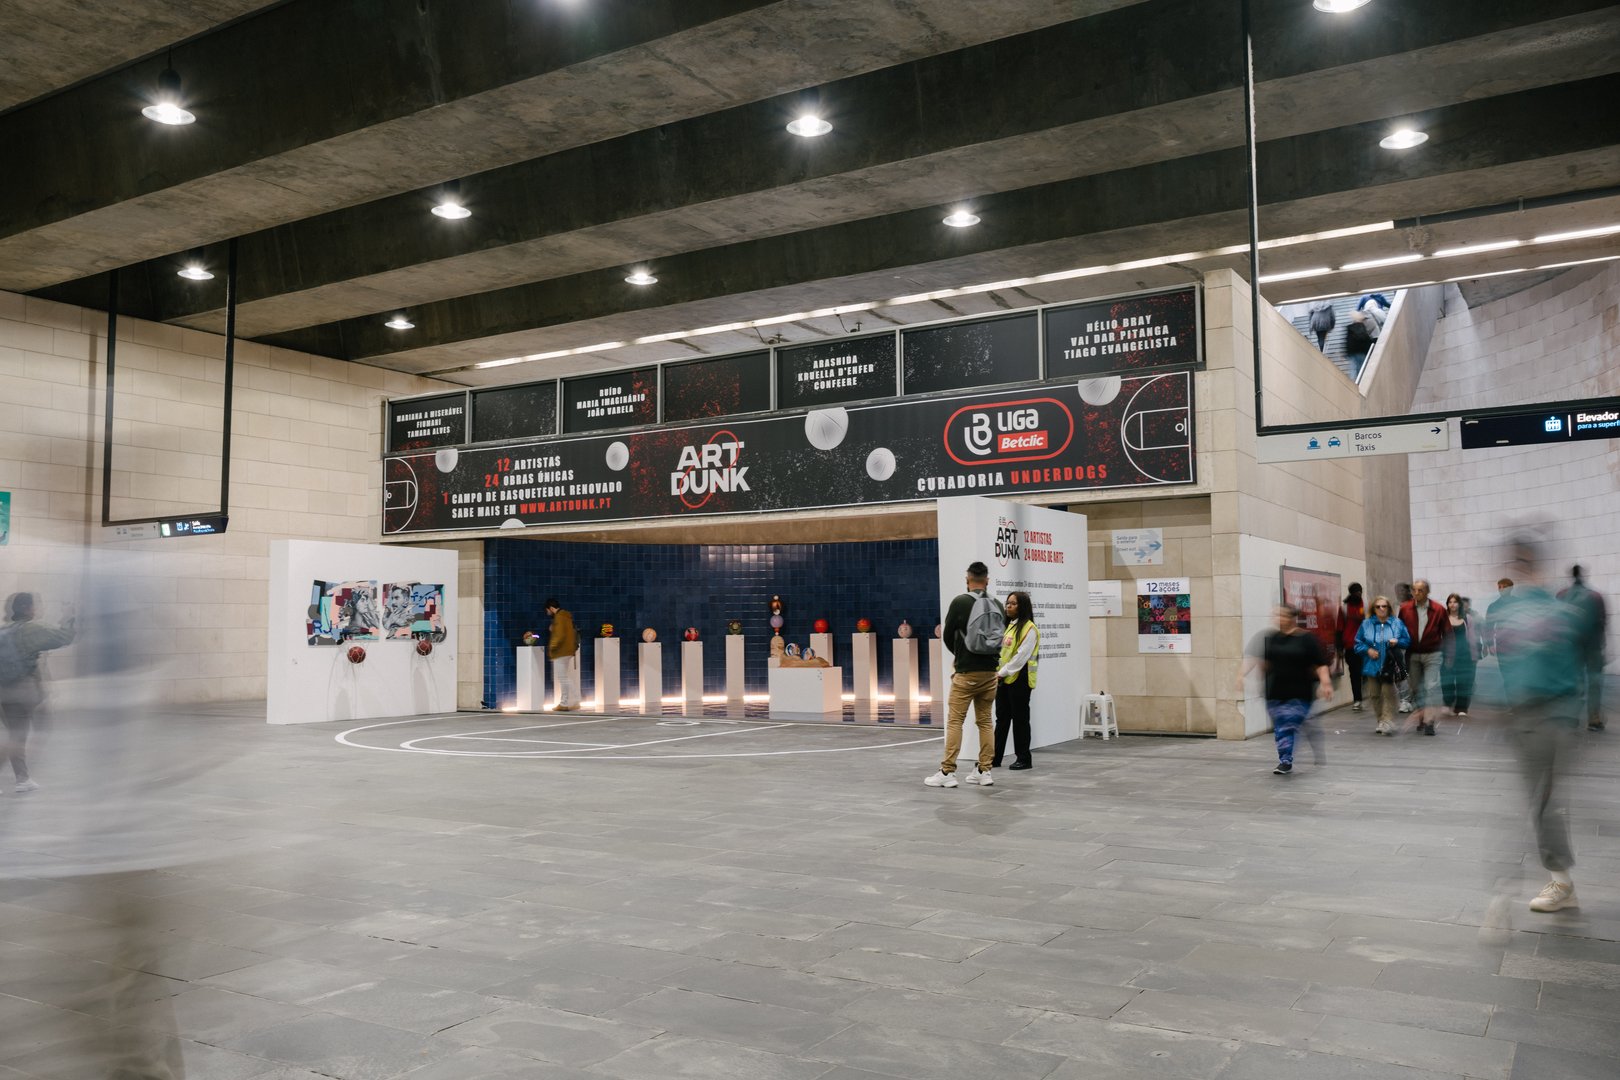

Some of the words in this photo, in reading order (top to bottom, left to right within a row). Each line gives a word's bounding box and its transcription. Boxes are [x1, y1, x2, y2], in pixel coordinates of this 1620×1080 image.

[1087, 319, 1118, 333] HÉLIO
[1122, 314, 1152, 328] BRAY
[1070, 335, 1089, 347] VAI
[1094, 332, 1115, 344] DAR
[1120, 324, 1170, 341] PITANGA
[1064, 346, 1097, 360] TIAGO
[1101, 336, 1177, 355] EVANGELISTA
[813, 355, 858, 369] ARASHIDA
[797, 368, 835, 382] KRUELLA
[837, 363, 874, 377] D'ENFER
[813, 376, 857, 390] CONFEERE
[576, 399, 599, 410] MARIA
[601, 393, 646, 407] IMAGINÁRIO
[396, 411, 423, 422] MARIANA
[429, 406, 463, 418] MISERÁVEL
[587, 407, 605, 418] JOÃO
[607, 404, 634, 415] VARELA
[1576, 411, 1619, 423] Elevador
[407, 427, 431, 438] TAMARA
[432, 426, 451, 435] ALVES
[1577, 423, 1592, 431] para
[1001, 434, 1044, 449] Betclic
[1354, 432, 1382, 441] Barcos
[676, 441, 745, 471] ART
[1355, 443, 1376, 452] Táxis
[497, 457, 510, 472] 12
[514, 455, 561, 471] ARTISTAS
[484, 473, 499, 488] 24
[503, 473, 534, 486] OBRAS
[537, 469, 574, 484] ÚNICAS
[670, 466, 751, 496] DUNK
[917, 471, 1004, 492] CURADORIA
[1010, 464, 1107, 485] UNDERDOGS
[441, 491, 448, 505] 1
[452, 492, 482, 505] CAMPO
[485, 491, 497, 502] DE
[500, 484, 565, 501] BASQUETEBOL
[570, 481, 622, 495] RENOVADO
[452, 507, 474, 519] SABE
[477, 505, 501, 517] MAIS
[504, 504, 517, 515] EM
[519, 497, 612, 514] WWW.ARTDUNK.PT
[996, 526, 1018, 544] ART
[1023, 530, 1029, 543] 12
[1030, 531, 1052, 546] ARTISTAS
[995, 542, 1020, 560] DUNK
[1024, 548, 1030, 561] 24
[1031, 548, 1047, 563] OBRAS
[1047, 550, 1053, 563] DE
[1053, 551, 1064, 564] ARTE
[1146, 582, 1158, 593] 12
